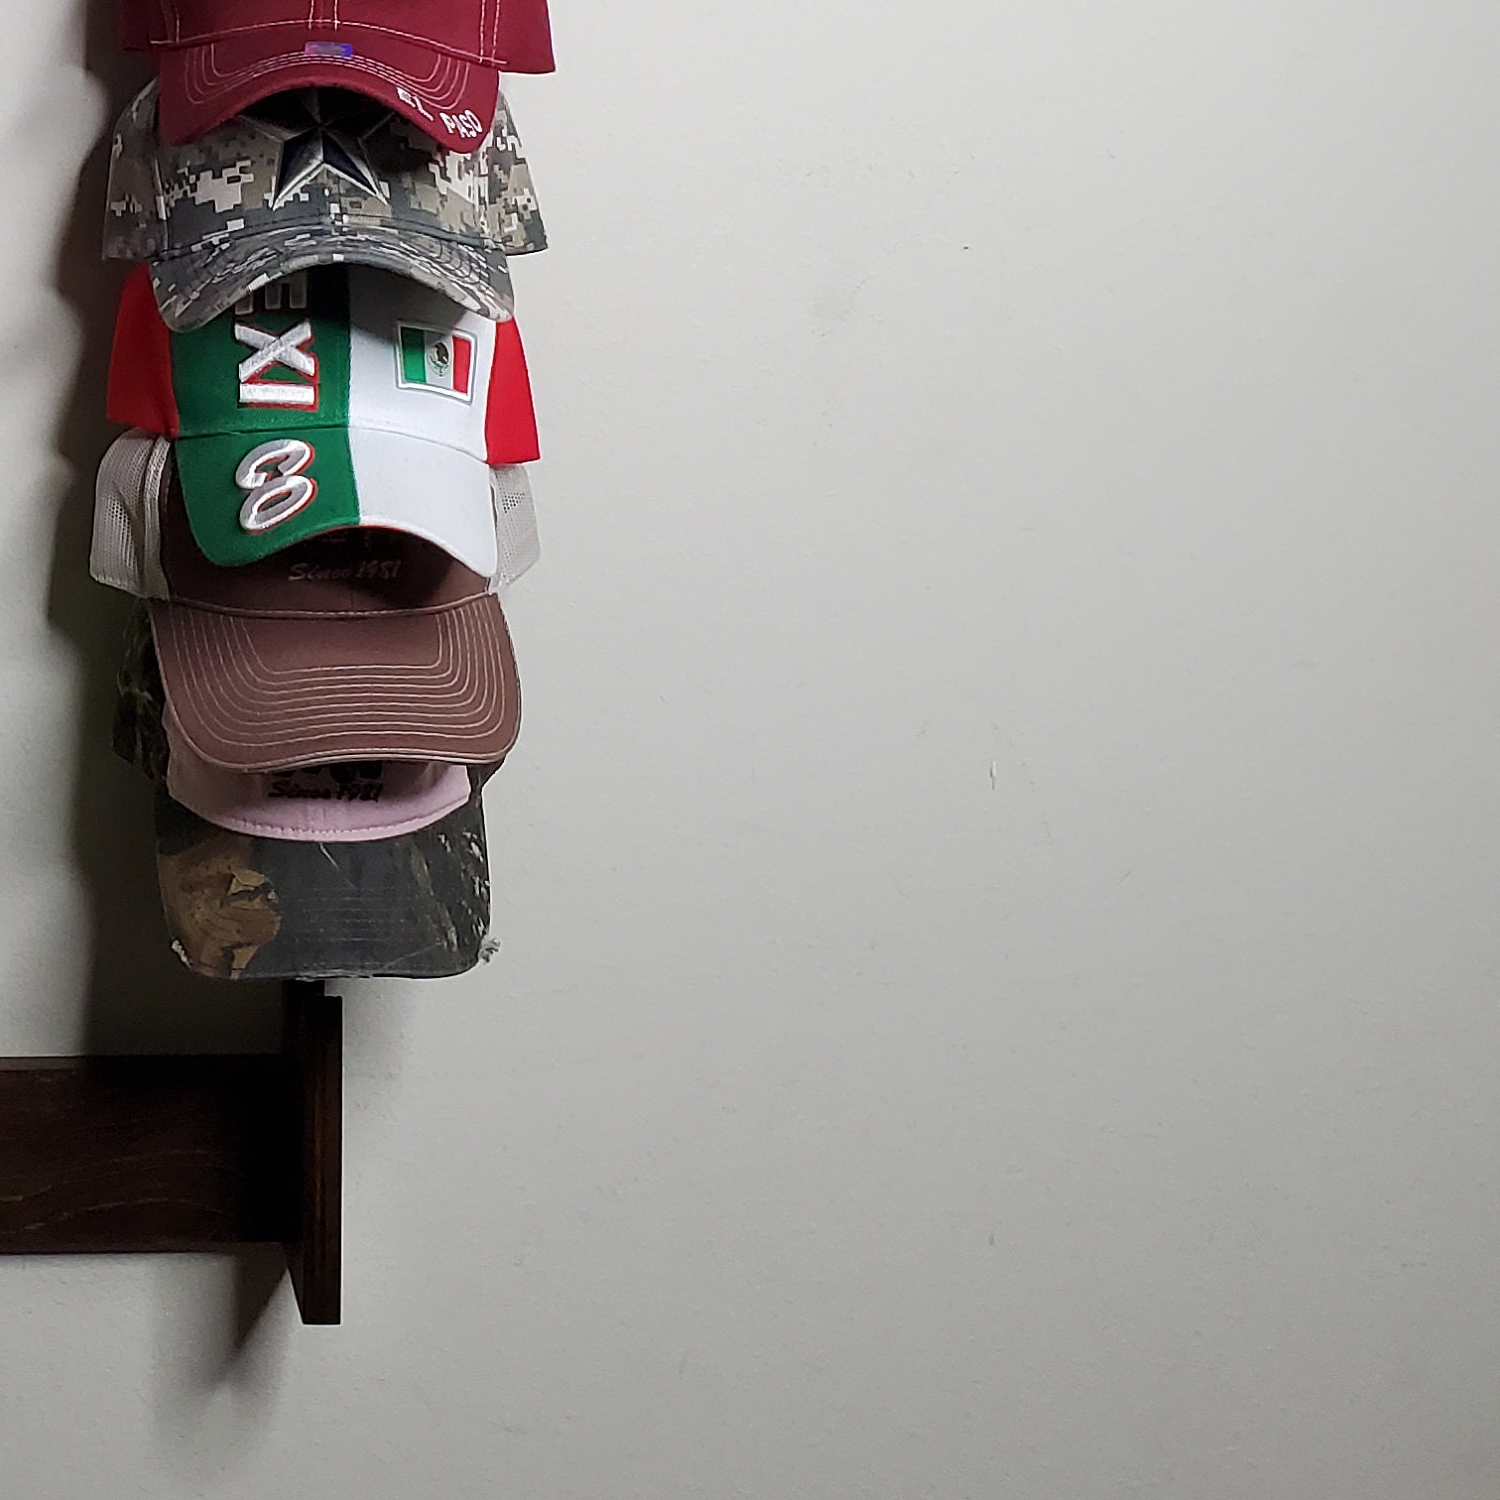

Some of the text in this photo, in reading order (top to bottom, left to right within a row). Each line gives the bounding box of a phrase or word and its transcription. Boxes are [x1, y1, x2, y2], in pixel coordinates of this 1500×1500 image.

[397, 88, 483, 142] EL PASO
[268, 779, 331, 800] Since
